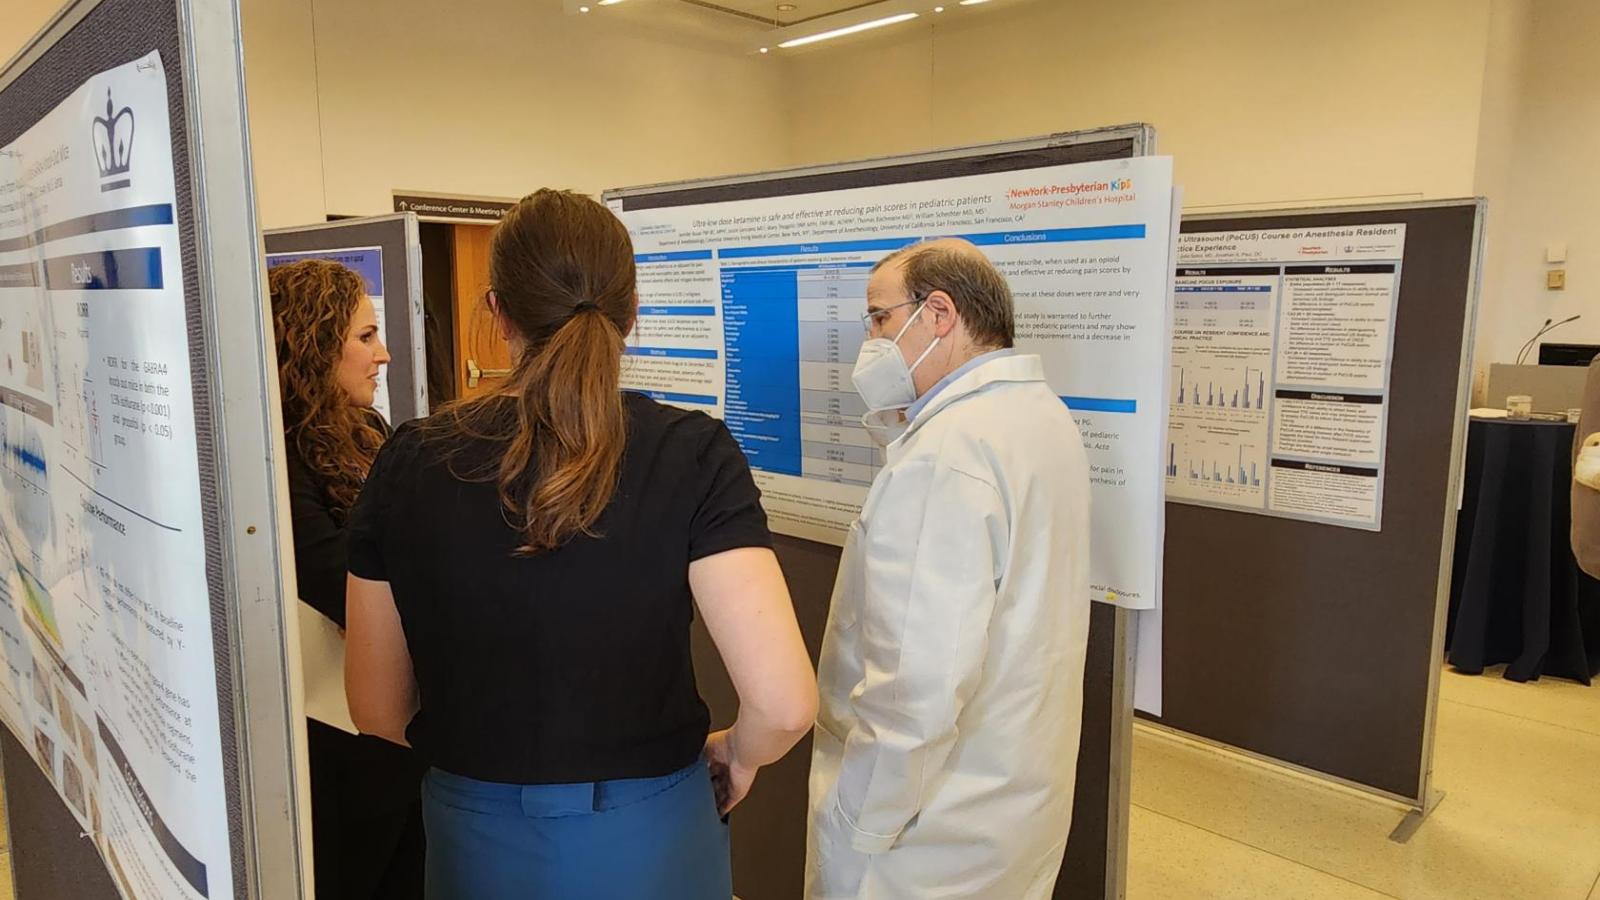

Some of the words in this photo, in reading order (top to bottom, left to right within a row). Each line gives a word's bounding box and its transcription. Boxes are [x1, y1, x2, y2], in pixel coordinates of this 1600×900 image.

[1009, 200, 1036, 211] Morgan
[1037, 198, 1063, 209] Stanley
[1065, 195, 1104, 207] Children's
[1104, 193, 1136, 206] Hospital
[410, 203, 447, 213] Conference
[447, 205, 469, 213] Center
[475, 207, 500, 216] Meeting
[718, 217, 733, 226] dose
[733, 215, 761, 226] ketamine
[762, 215, 767, 223] is
[768, 213, 781, 223] safe
[782, 211, 795, 221] and
[795, 209, 824, 220] effective
[824, 208, 833, 218] at
[833, 204, 865, 218] reducing
[866, 203, 882, 216] pain
[883, 202, 908, 213] scores
[909, 200, 917, 210] in
[918, 198, 955, 211] pediatric
[956, 194, 992, 208] patients
[974, 216, 985, 224] San
[1004, 233, 1047, 243] Conclusions
[1184, 235, 1225, 243] Ultrasound
[1225, 233, 1259, 242] (PoCUS)
[1261, 232, 1291, 240] Course
[1304, 230, 1354, 238] Anesthesia
[1356, 227, 1397, 236] Resident
[1194, 244, 1237, 253] Experience
[1016, 258, 1043, 267] describe,
[1045, 256, 1063, 265] when
[1063, 256, 1079, 264] used
[1088, 256, 1098, 264] an
[1098, 255, 1120, 266] opioid
[70, 259, 92, 285] Results
[1008, 268, 1020, 276] and
[1020, 267, 1046, 276] effective
[1054, 266, 1083, 276] reducing
[1083, 266, 1098, 275] pain
[1099, 266, 1121, 274] scores
[1122, 265, 1131, 275] by
[1031, 290, 1038, 298] at
[1038, 289, 1057, 298] these
[1056, 289, 1075, 298] doses
[1107, 289, 1122, 297] and
[1122, 290, 1140, 299] very
[1023, 312, 1040, 321] study
[1046, 312, 1079, 320] warranted
[1079, 312, 1088, 320] to
[1087, 312, 1112, 320] further
[1032, 322, 1059, 331] pediatric
[1059, 322, 1086, 332] patients
[1100, 324, 1115, 332] may
[1116, 323, 1136, 331] show
[1033, 332, 1072, 341] requirement
[1072, 332, 1085, 340] and
[1091, 333, 1123, 341] decrease
[156, 384, 169, 397] the
[154, 423, 173, 440] 0.05)
[1089, 431, 1120, 440] pediatric
[1094, 442, 1110, 451] Acta
[1089, 465, 1100, 473] for
[1100, 466, 1116, 474] pain
[1116, 467, 1124, 475] in
[1118, 478, 1126, 487] of
